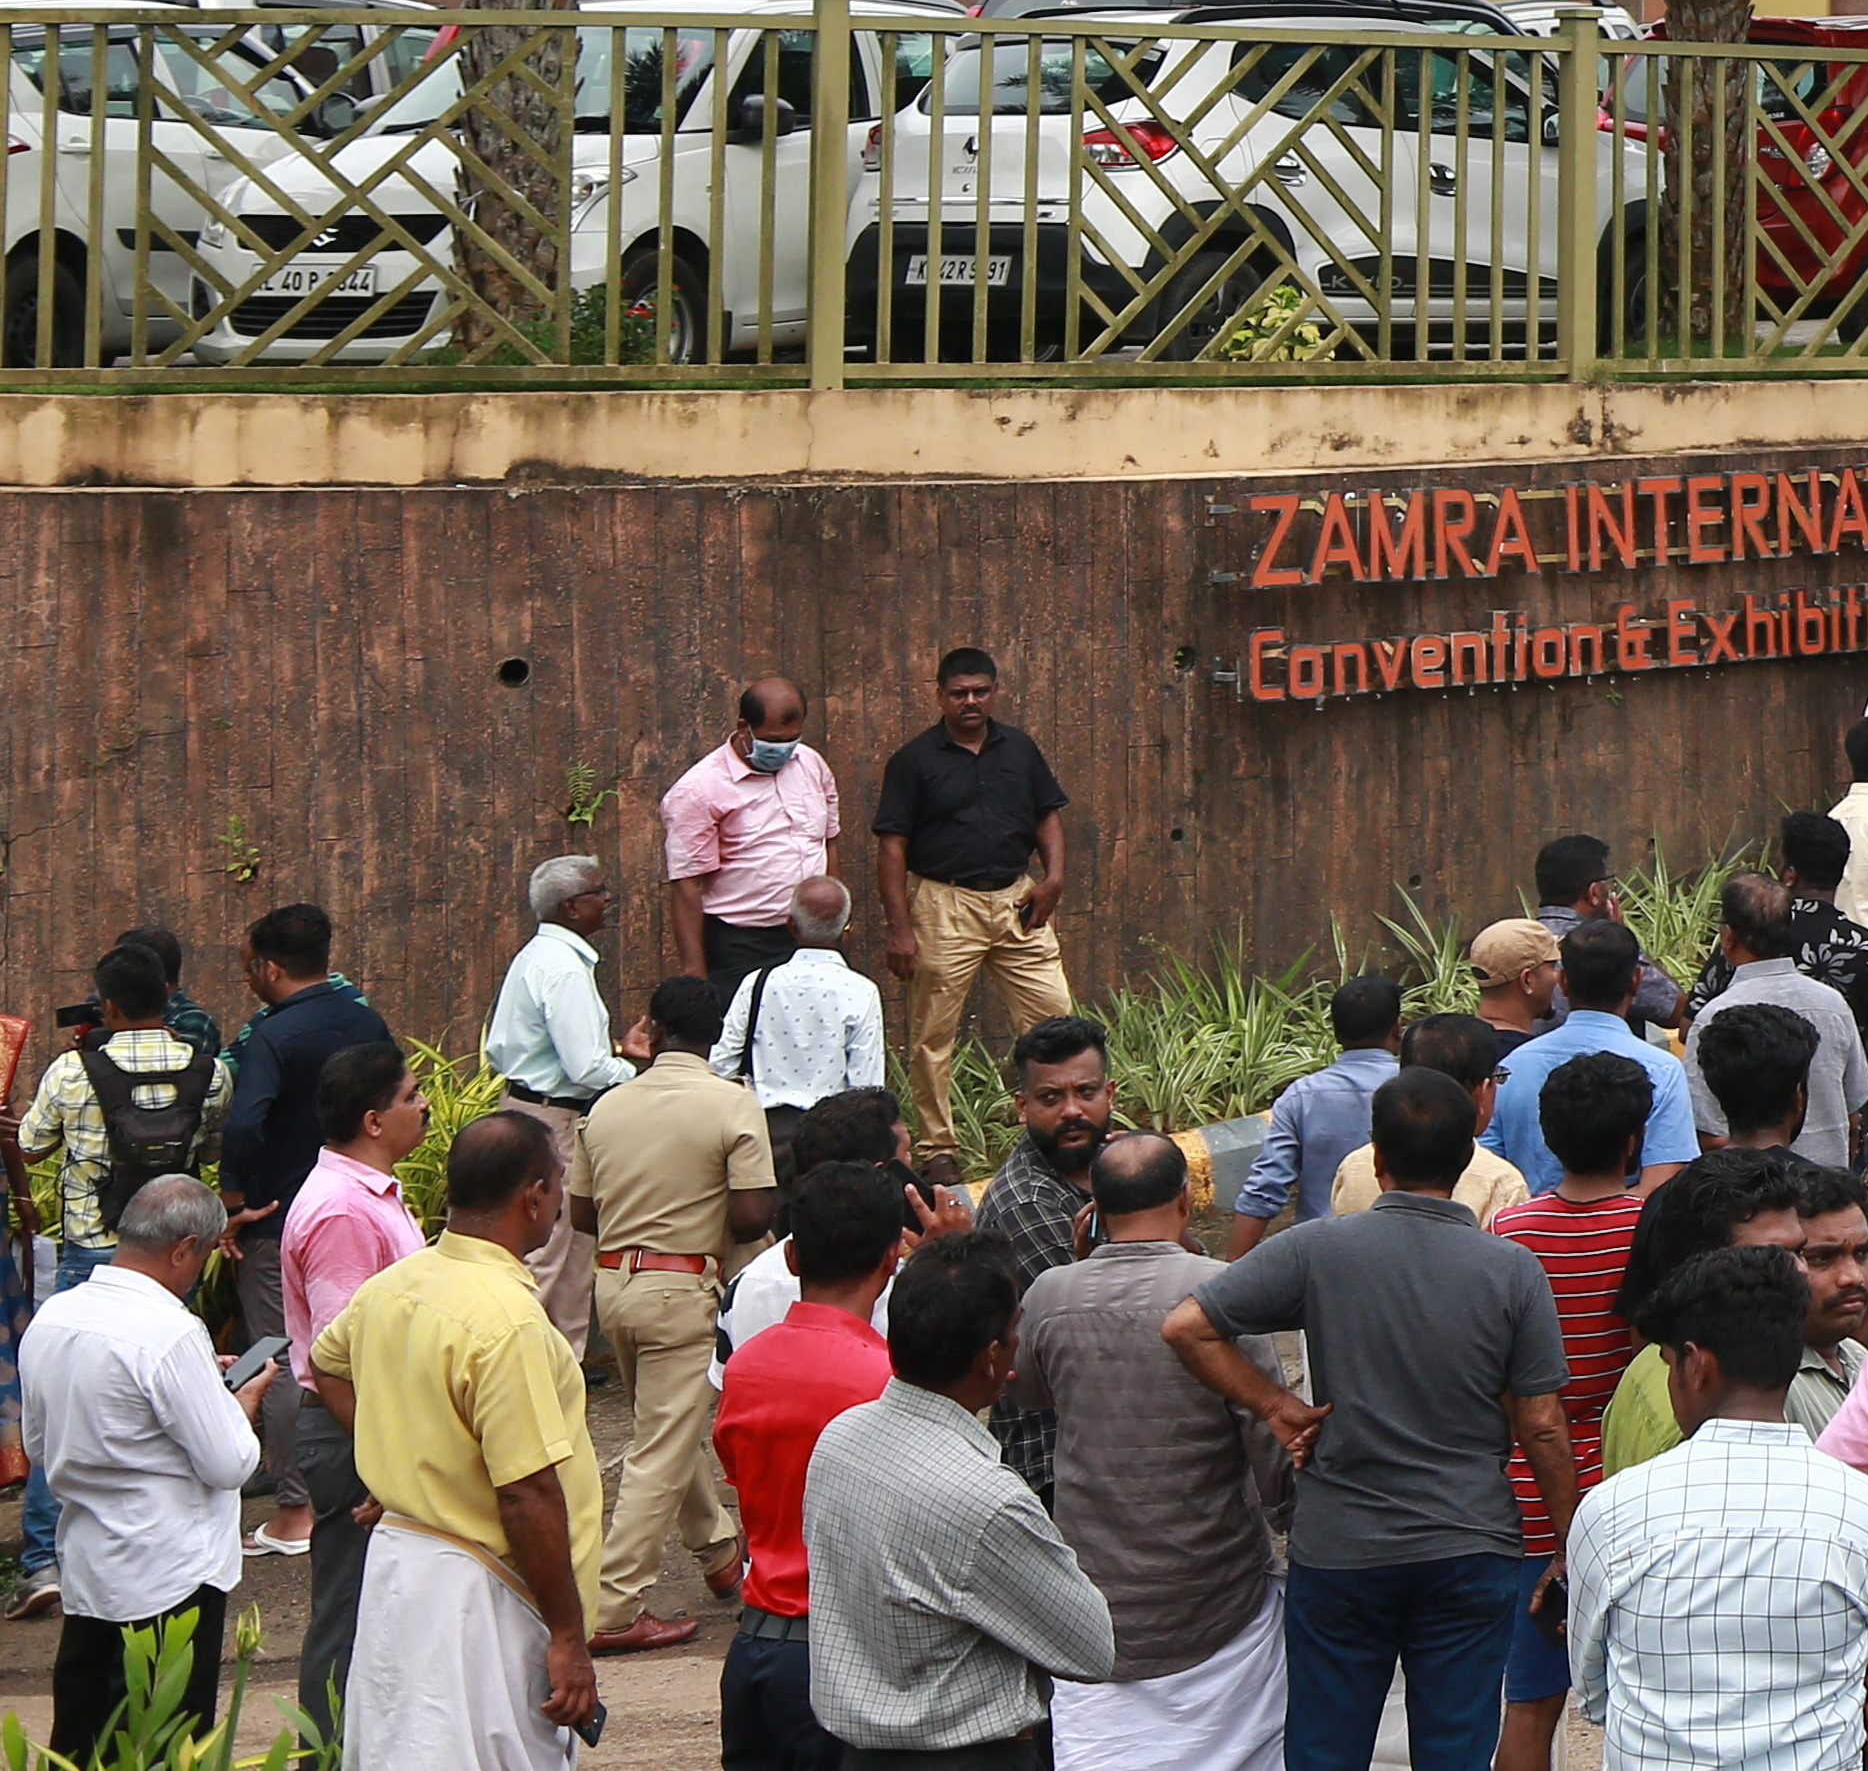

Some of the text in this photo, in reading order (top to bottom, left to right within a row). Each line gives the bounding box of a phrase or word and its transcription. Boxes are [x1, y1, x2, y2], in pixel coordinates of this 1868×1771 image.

[1248, 482, 1541, 590] ZAMRA
[1248, 609, 1604, 702] Convention
[1615, 602, 1652, 671] &
